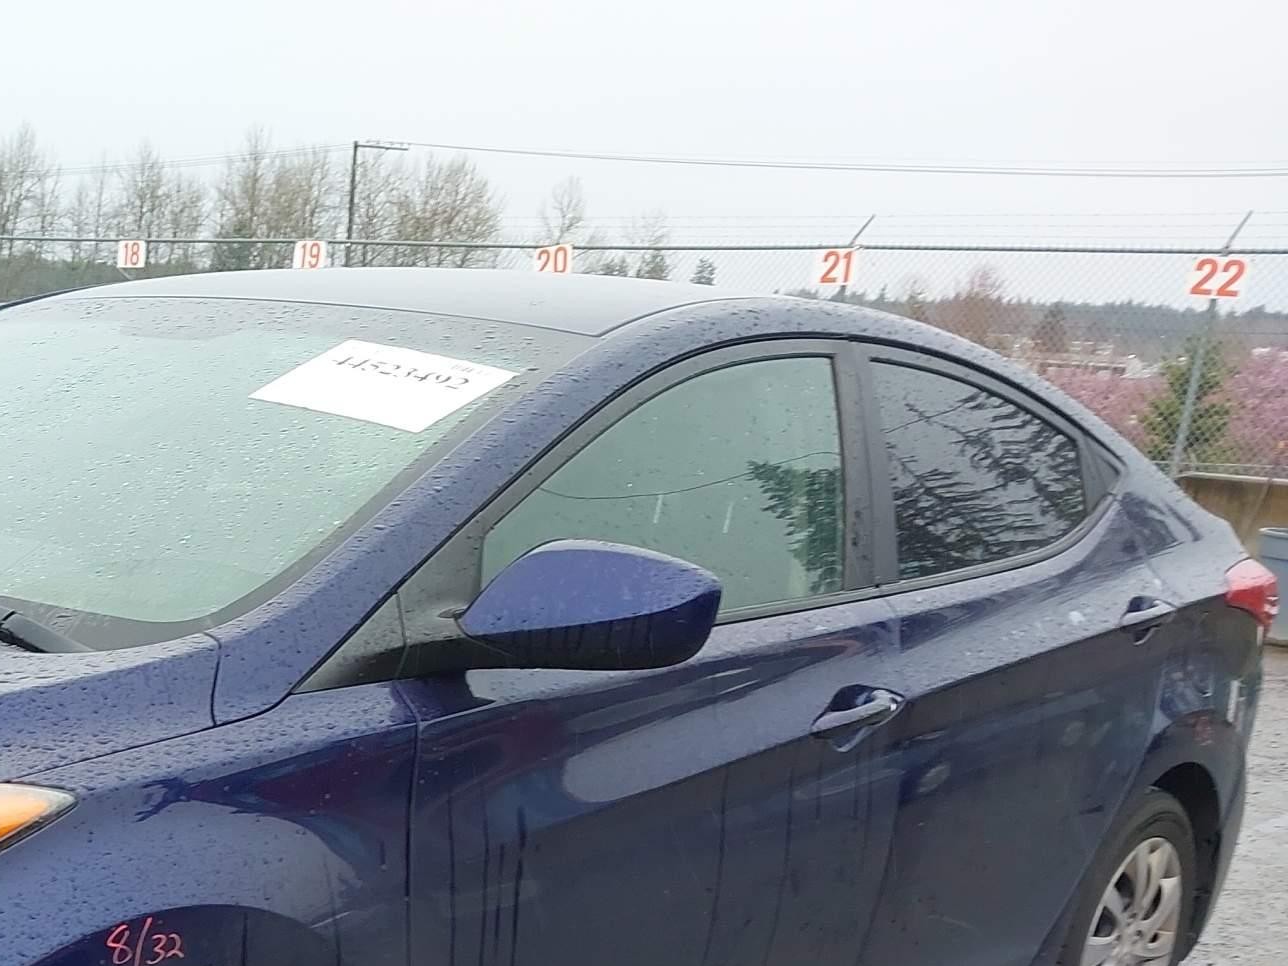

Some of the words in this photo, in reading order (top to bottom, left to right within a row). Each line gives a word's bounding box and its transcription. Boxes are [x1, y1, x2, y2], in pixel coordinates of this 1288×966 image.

[123, 242, 140, 266] 18
[300, 242, 321, 268] 19
[536, 246, 568, 273] 20
[819, 250, 854, 283] 21
[1190, 257, 1246, 297] 22
